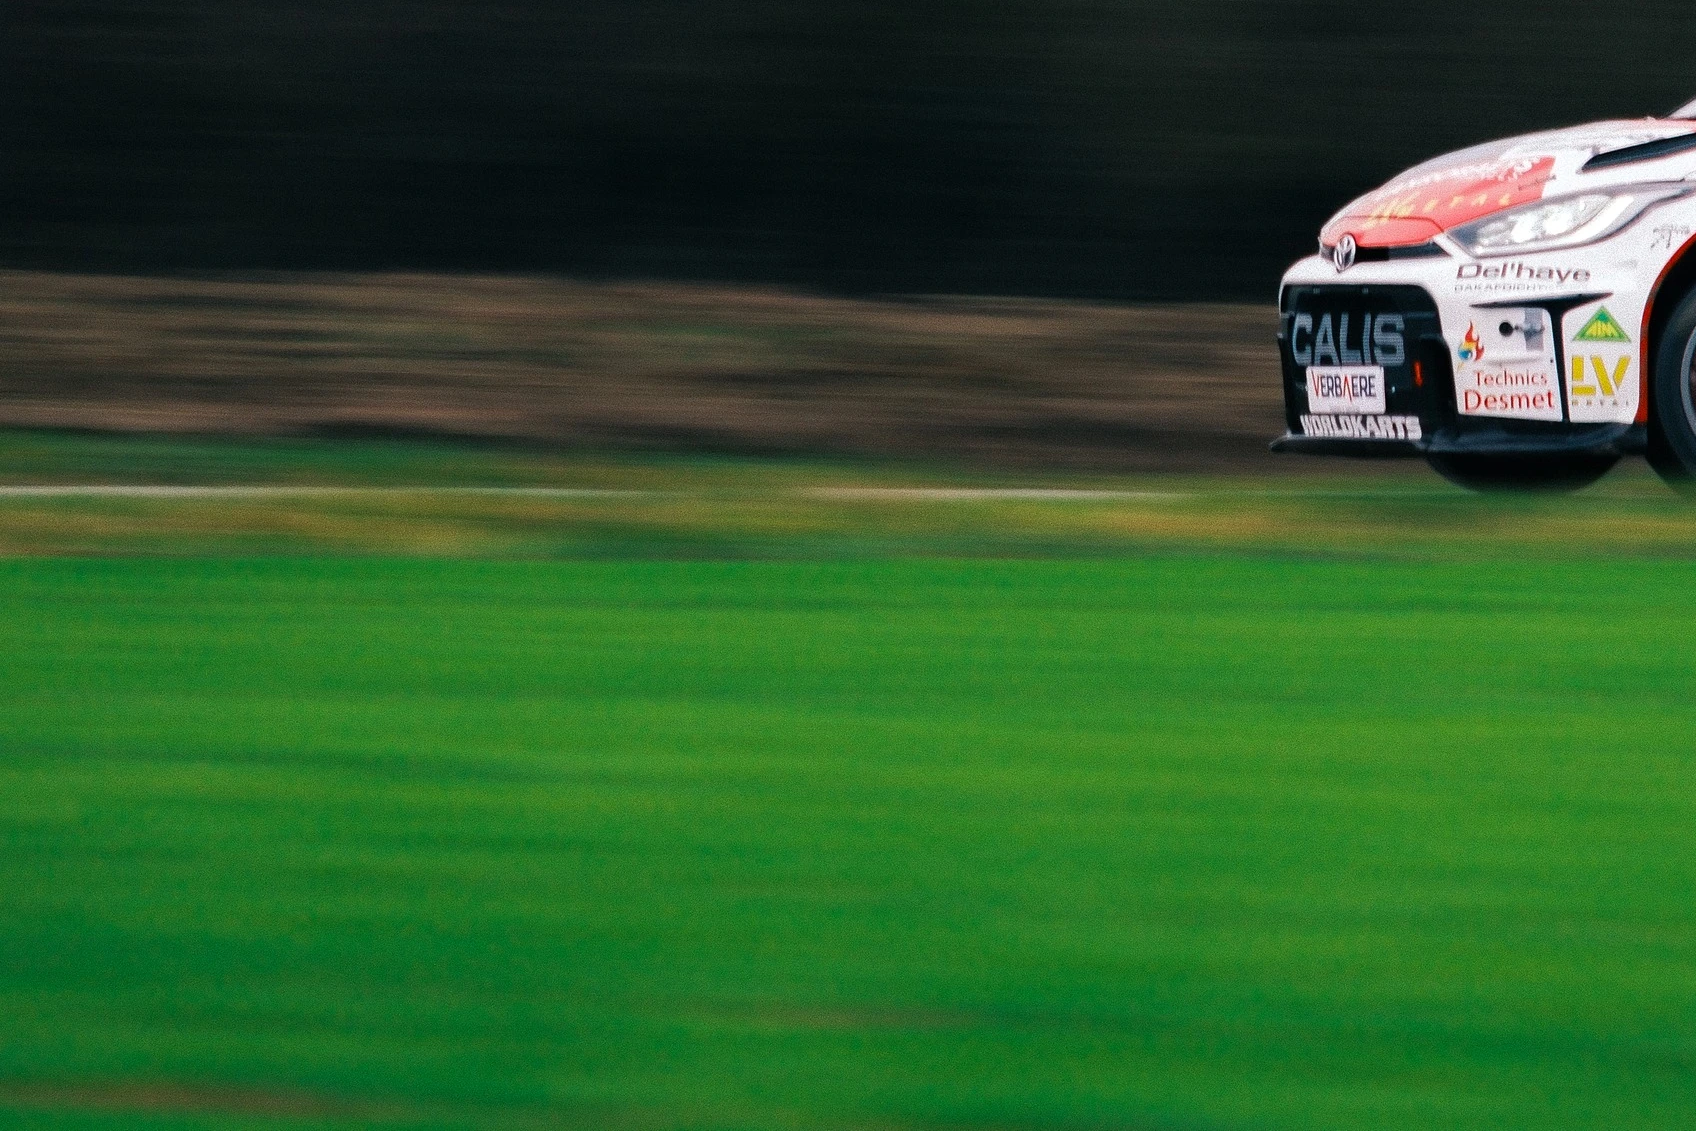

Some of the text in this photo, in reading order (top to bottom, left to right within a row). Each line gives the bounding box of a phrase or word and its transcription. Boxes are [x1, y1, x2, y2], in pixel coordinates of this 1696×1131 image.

[1291, 312, 1406, 367] CALIS
[1475, 370, 1548, 387] Technics
[1571, 355, 1632, 397] LV
[1464, 388, 1555, 414] Desmet
